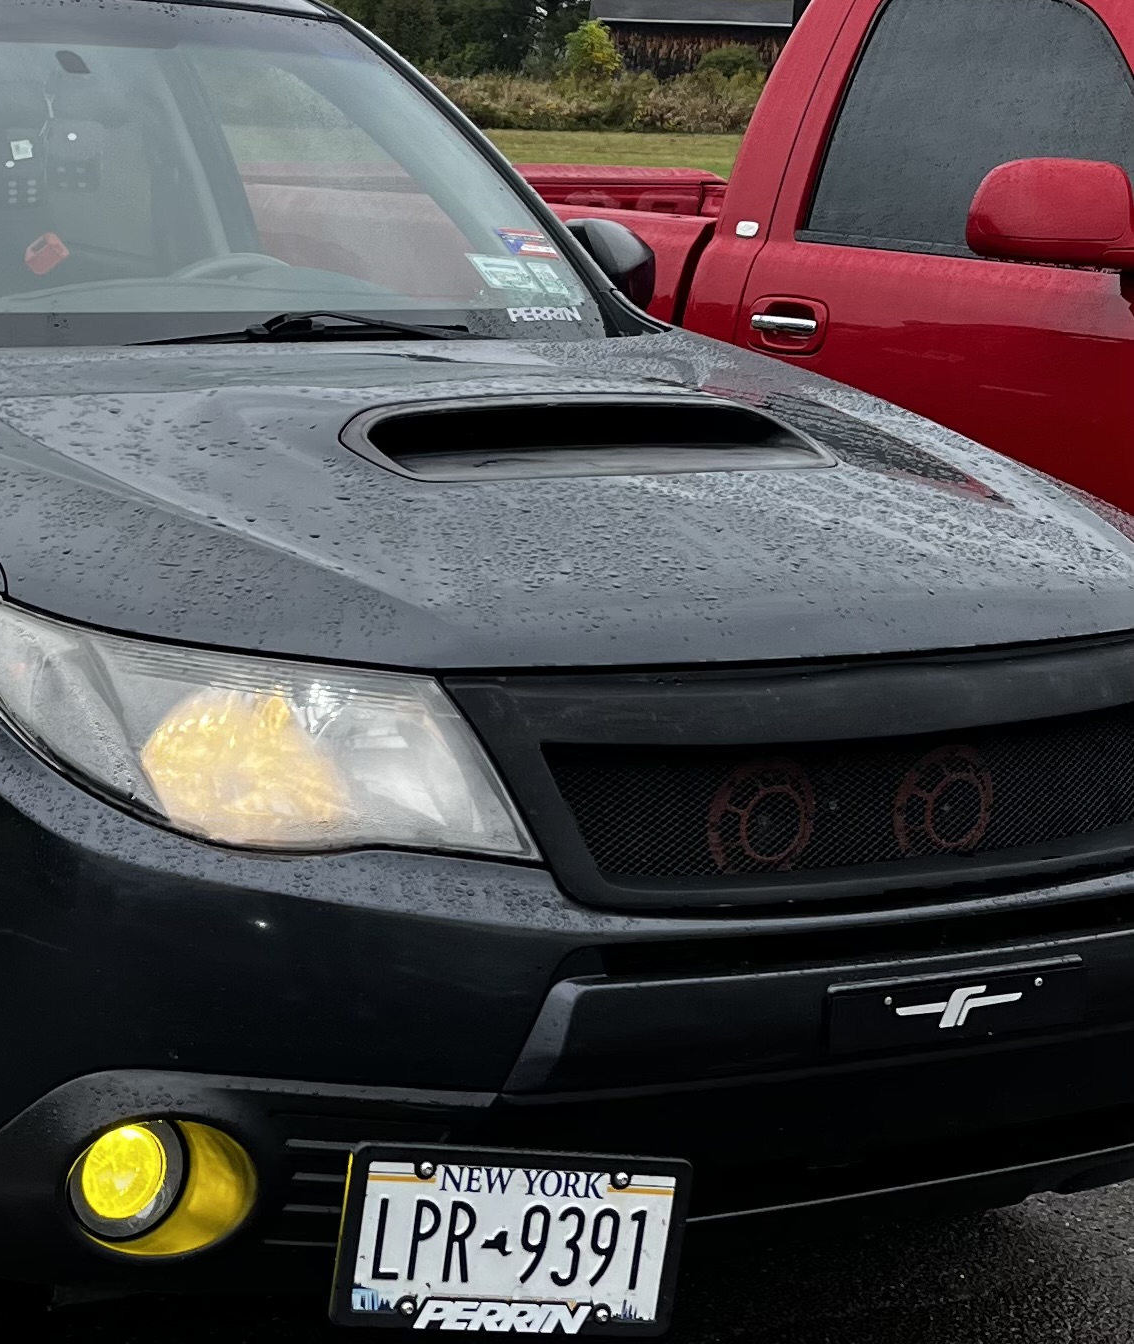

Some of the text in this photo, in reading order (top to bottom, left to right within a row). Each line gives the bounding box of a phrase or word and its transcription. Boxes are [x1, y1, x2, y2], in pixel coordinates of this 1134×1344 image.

[506, 306, 582, 323] PERRIN
[439, 1165, 608, 1199] NEW YORK
[371, 1197, 648, 1290] LPR 9391
[413, 1299, 593, 1335] PERRIN
